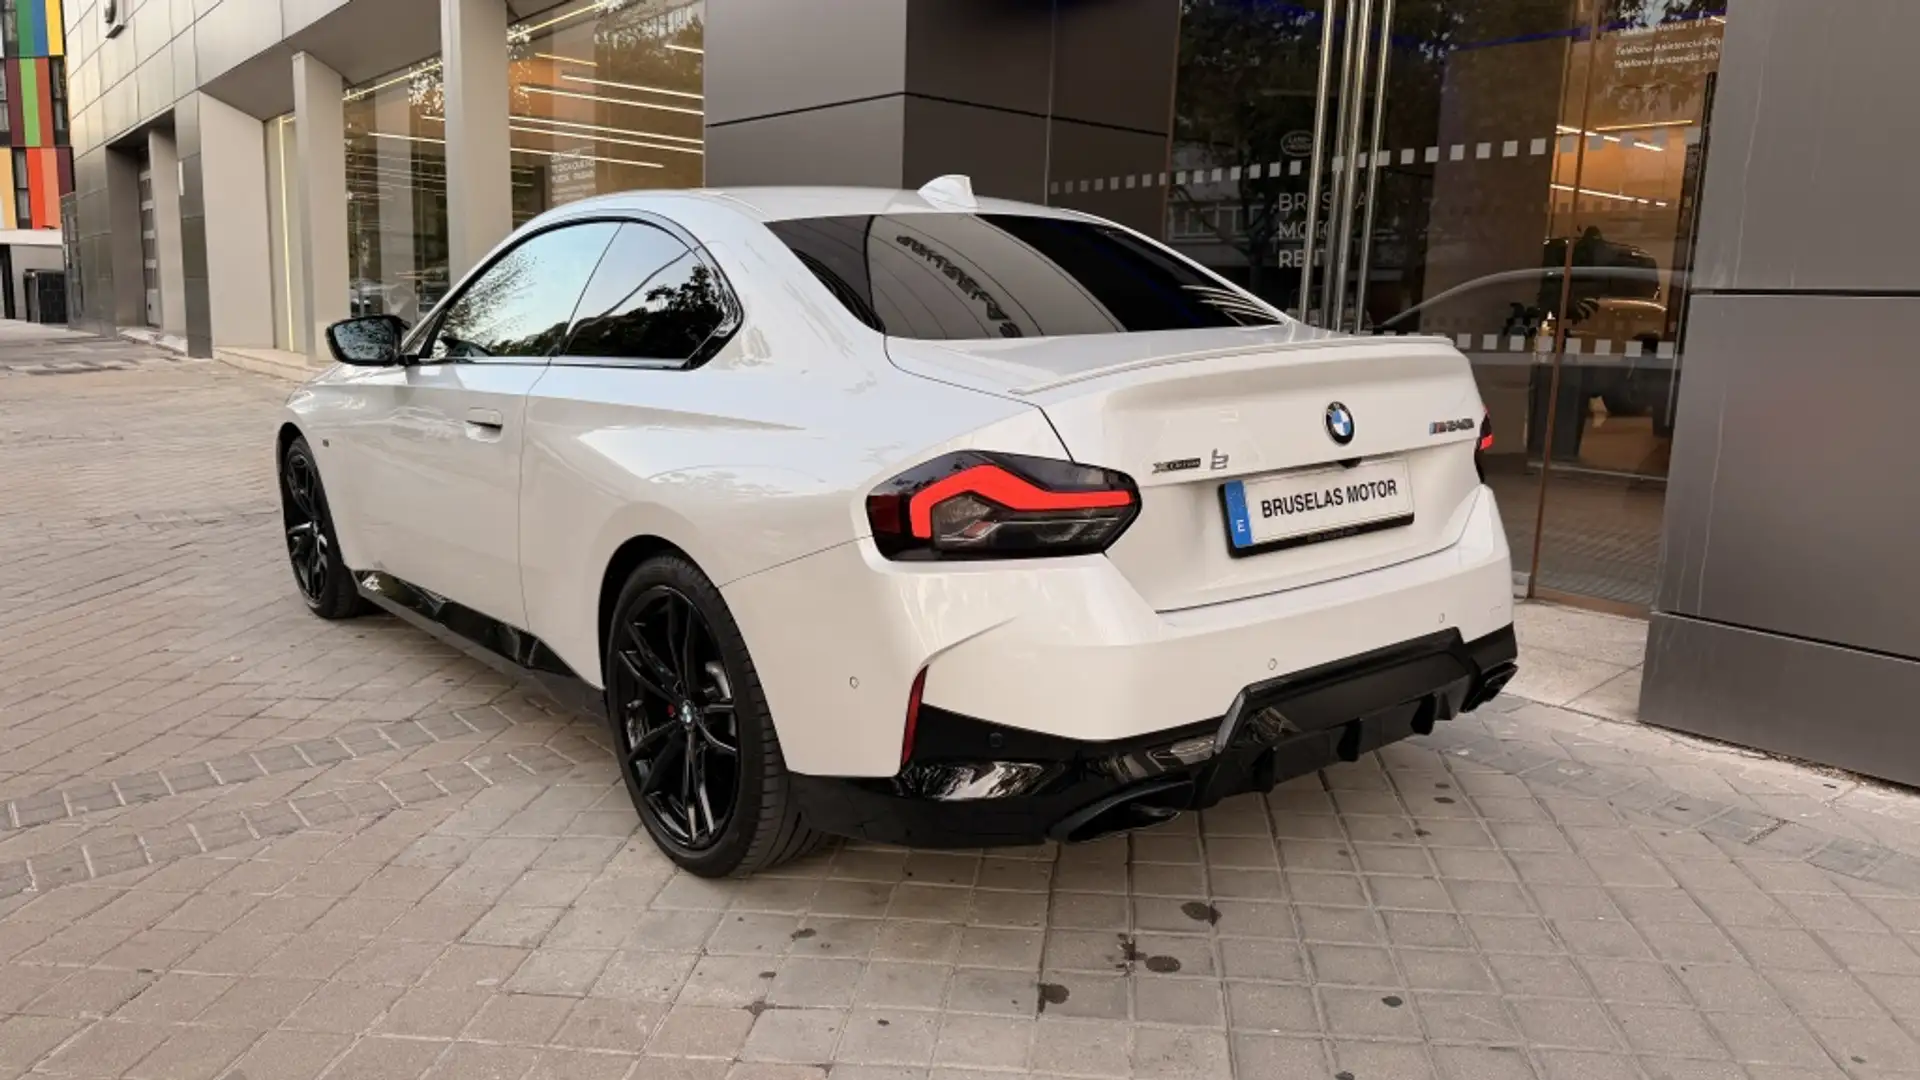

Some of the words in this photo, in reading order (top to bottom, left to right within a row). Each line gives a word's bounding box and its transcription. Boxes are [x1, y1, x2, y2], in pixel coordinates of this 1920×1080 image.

[1261, 487, 1344, 518] BRUSELAS
[1346, 479, 1398, 504] MOTOR
[1236, 519, 1246, 532] E
